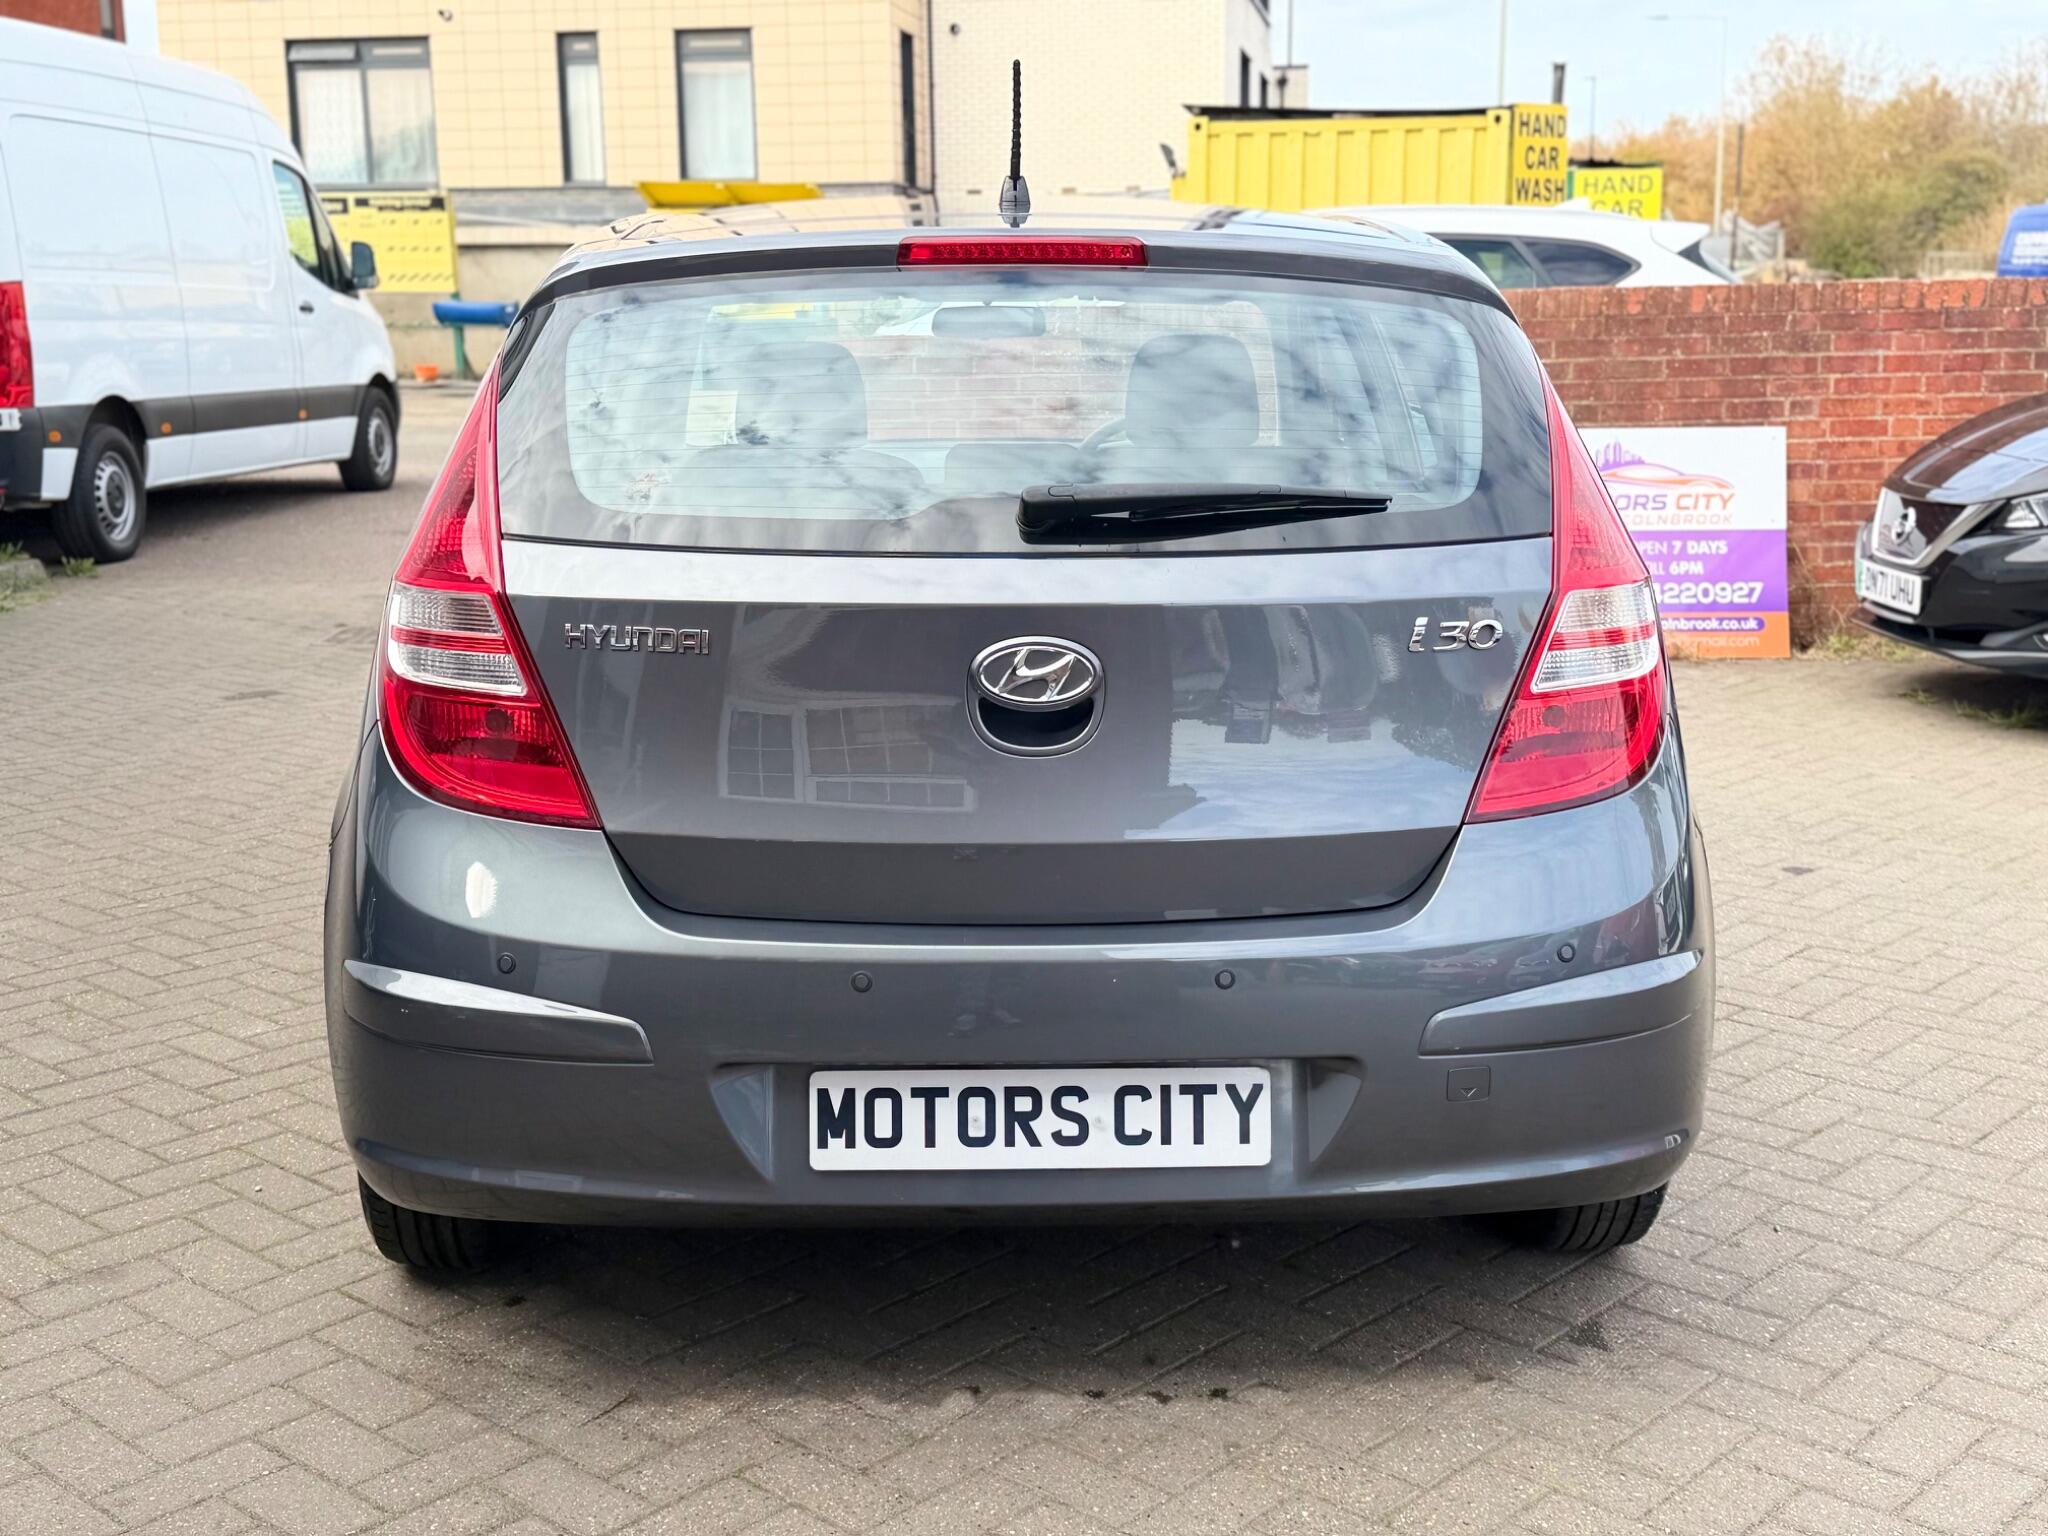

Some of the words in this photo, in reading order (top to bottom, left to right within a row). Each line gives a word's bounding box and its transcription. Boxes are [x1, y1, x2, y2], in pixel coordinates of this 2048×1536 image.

[1519, 112, 1566, 138] HAND
[1525, 145, 1560, 170] CAR
[1515, 177, 1565, 203] WASH
[1583, 174, 1654, 195] HAND
[1615, 494, 1668, 510] ORS
[1676, 493, 1735, 511] CITY
[1636, 540, 1668, 555] PEN
[1671, 540, 1683, 555] 7
[1687, 540, 1729, 555] DAYS
[1669, 561, 1705, 575] 6PM
[1661, 617, 1759, 631] olnbrook.co.uk
[564, 623, 710, 655] HYUNDAI
[816, 1085, 1090, 1149] MOTORS
[1113, 1083, 1265, 1147] CITY
